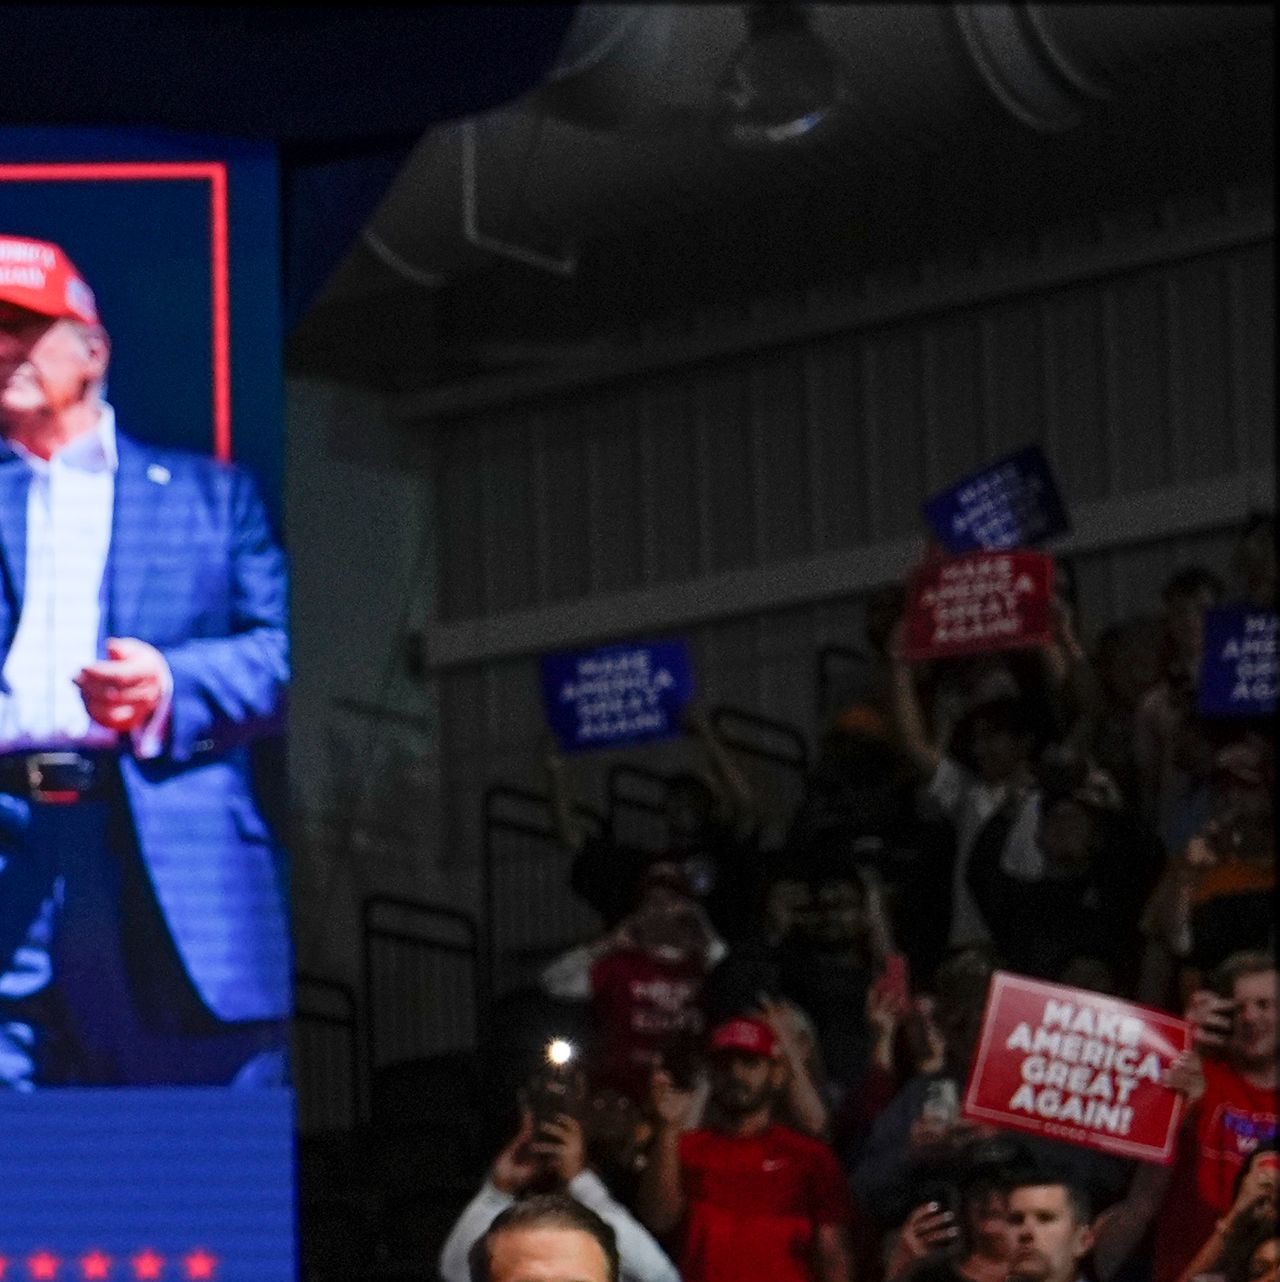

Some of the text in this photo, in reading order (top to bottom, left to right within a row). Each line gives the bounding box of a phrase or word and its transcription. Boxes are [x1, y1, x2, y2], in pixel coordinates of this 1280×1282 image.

[1005, 1021, 1161, 1083] AMERICA
[1021, 1054, 1139, 1105] GREAT
[1009, 1083, 1134, 1136] AGAIN!
